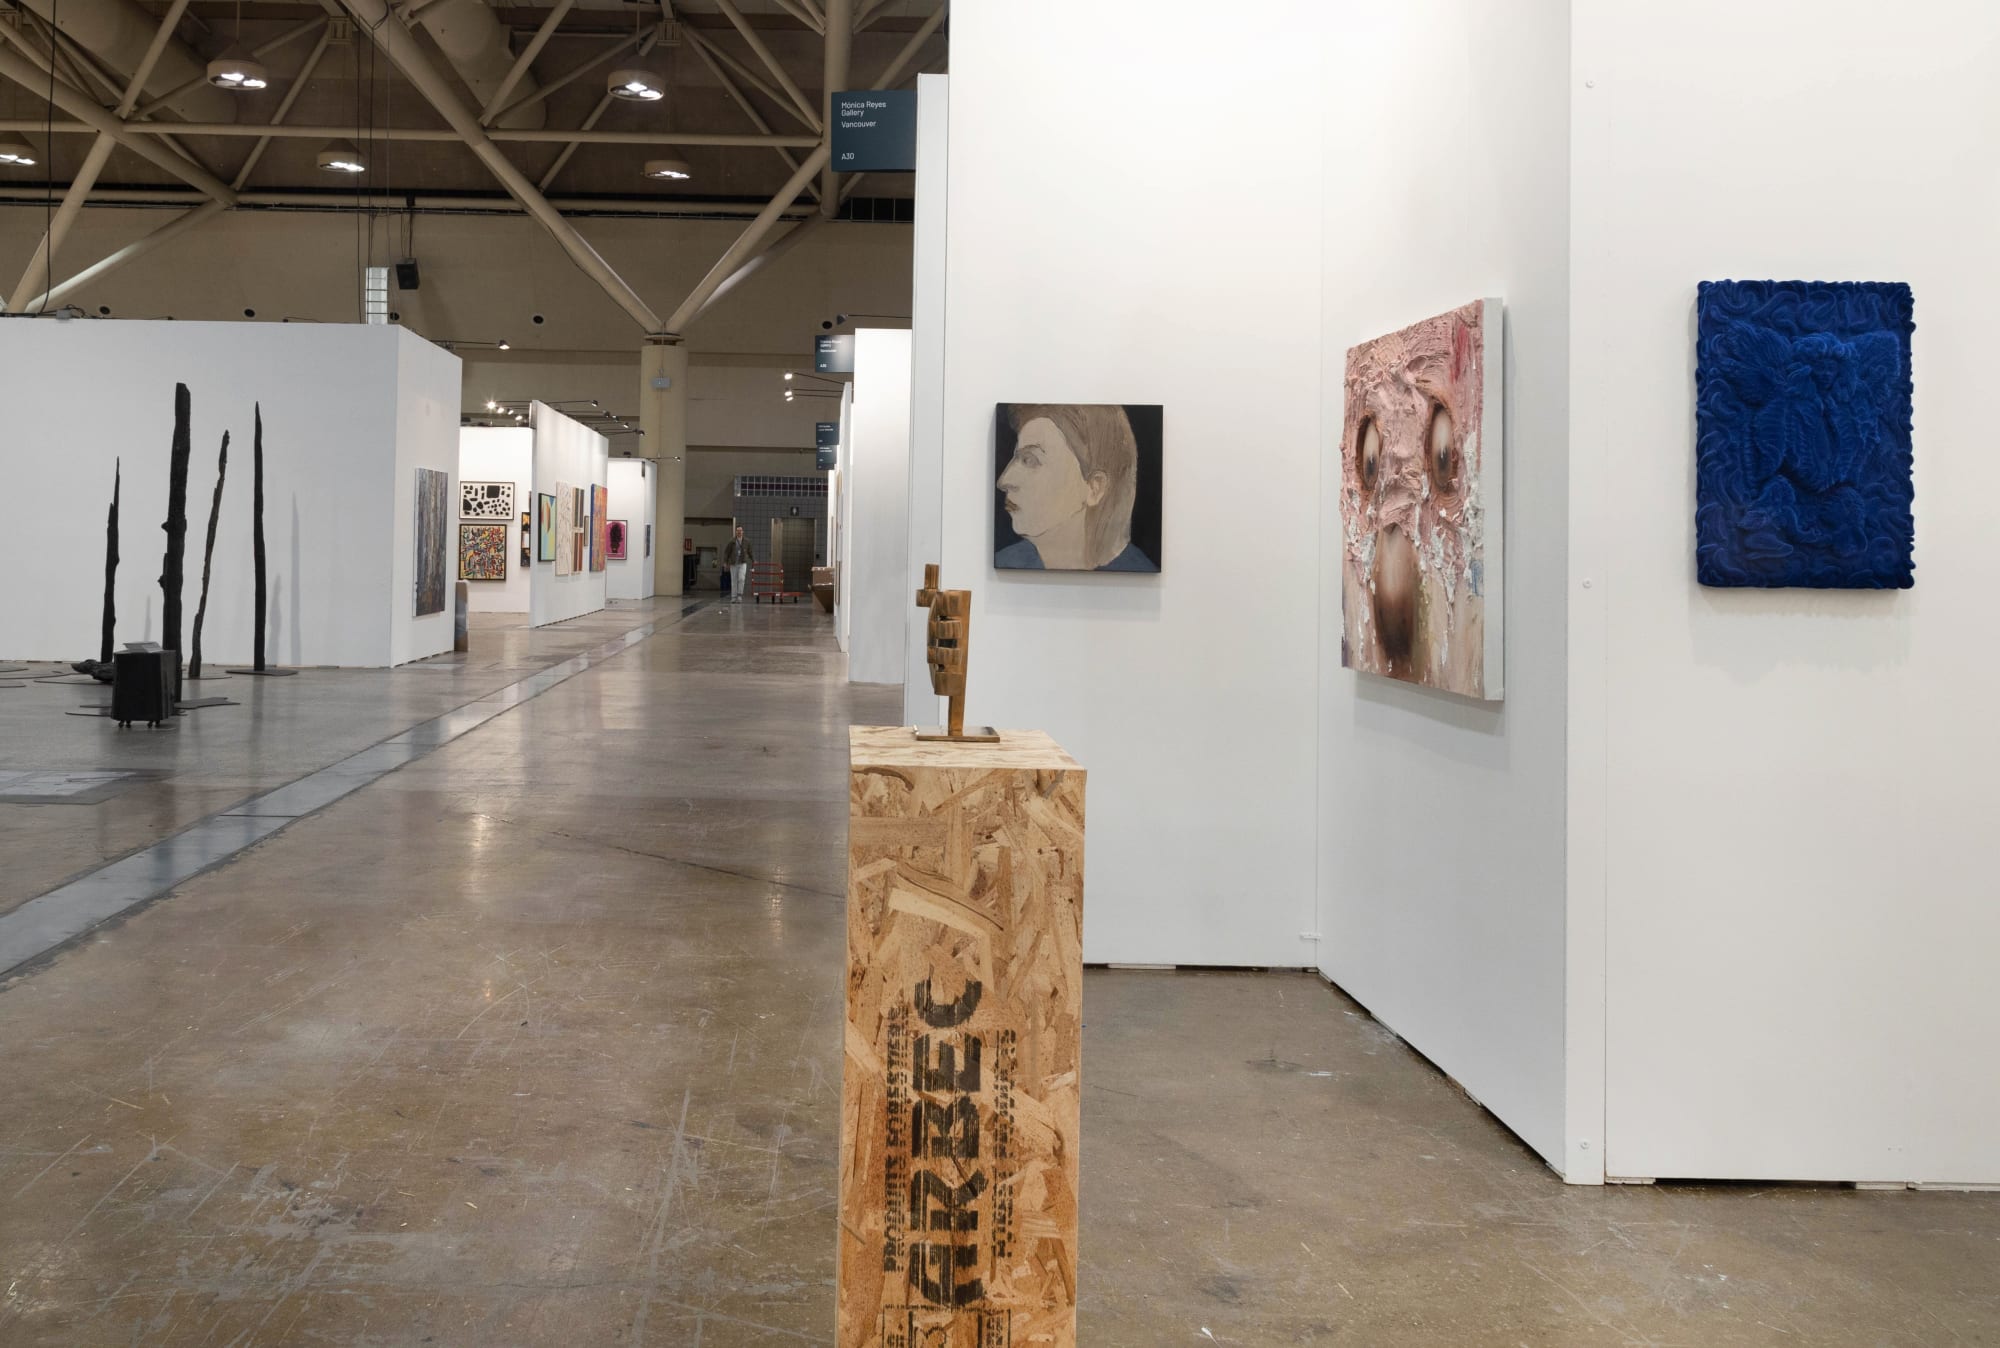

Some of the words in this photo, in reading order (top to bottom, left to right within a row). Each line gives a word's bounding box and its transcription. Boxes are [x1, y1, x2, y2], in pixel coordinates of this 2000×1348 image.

[866, 101, 887, 109] Reyes
[841, 109, 865, 118] Gallery
[841, 120, 877, 128] Vancouver
[841, 152, 855, 160] A30
[909, 977, 989, 1306] ARBEC
